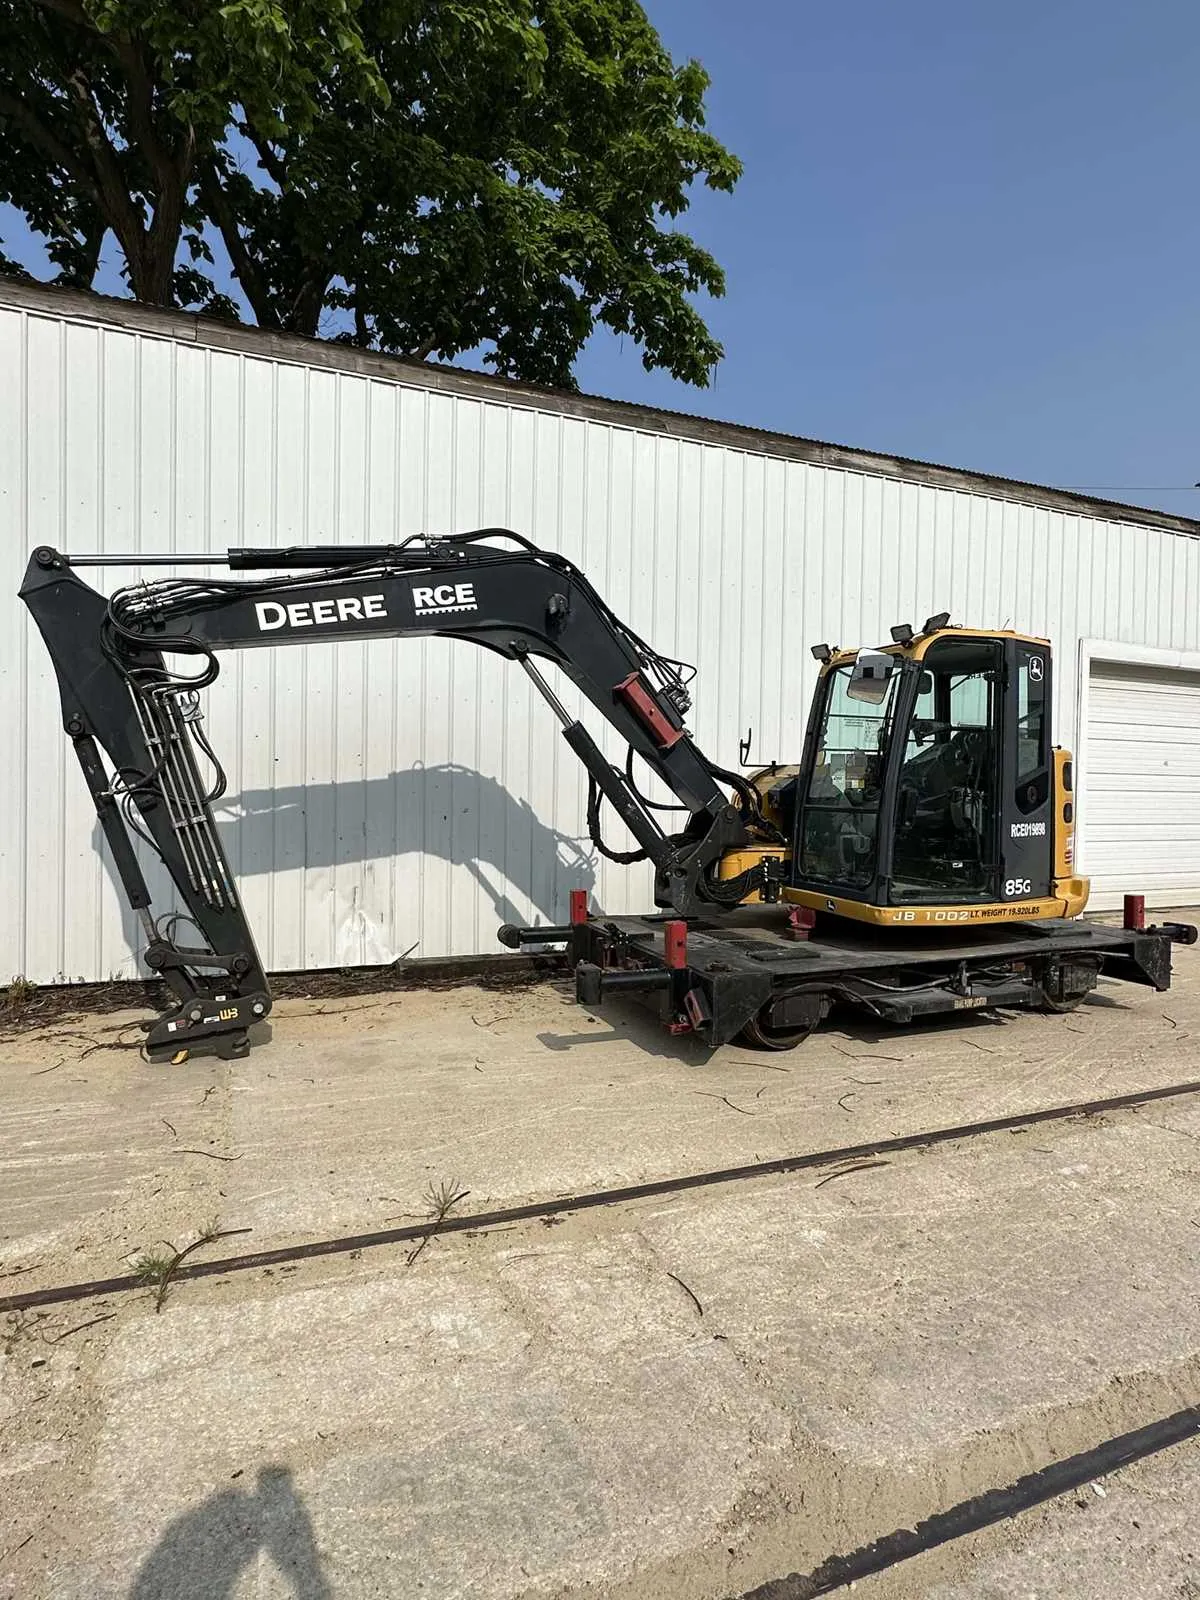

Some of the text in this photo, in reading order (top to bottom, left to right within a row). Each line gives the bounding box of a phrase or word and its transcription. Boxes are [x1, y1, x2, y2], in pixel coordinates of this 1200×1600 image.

[412, 583, 476, 607] RCE
[255, 595, 387, 630] DEERE
[1005, 879, 1031, 895] 85G
[893, 911, 969, 921] JB 1002
[982, 908, 1007, 918] WEIGHT
